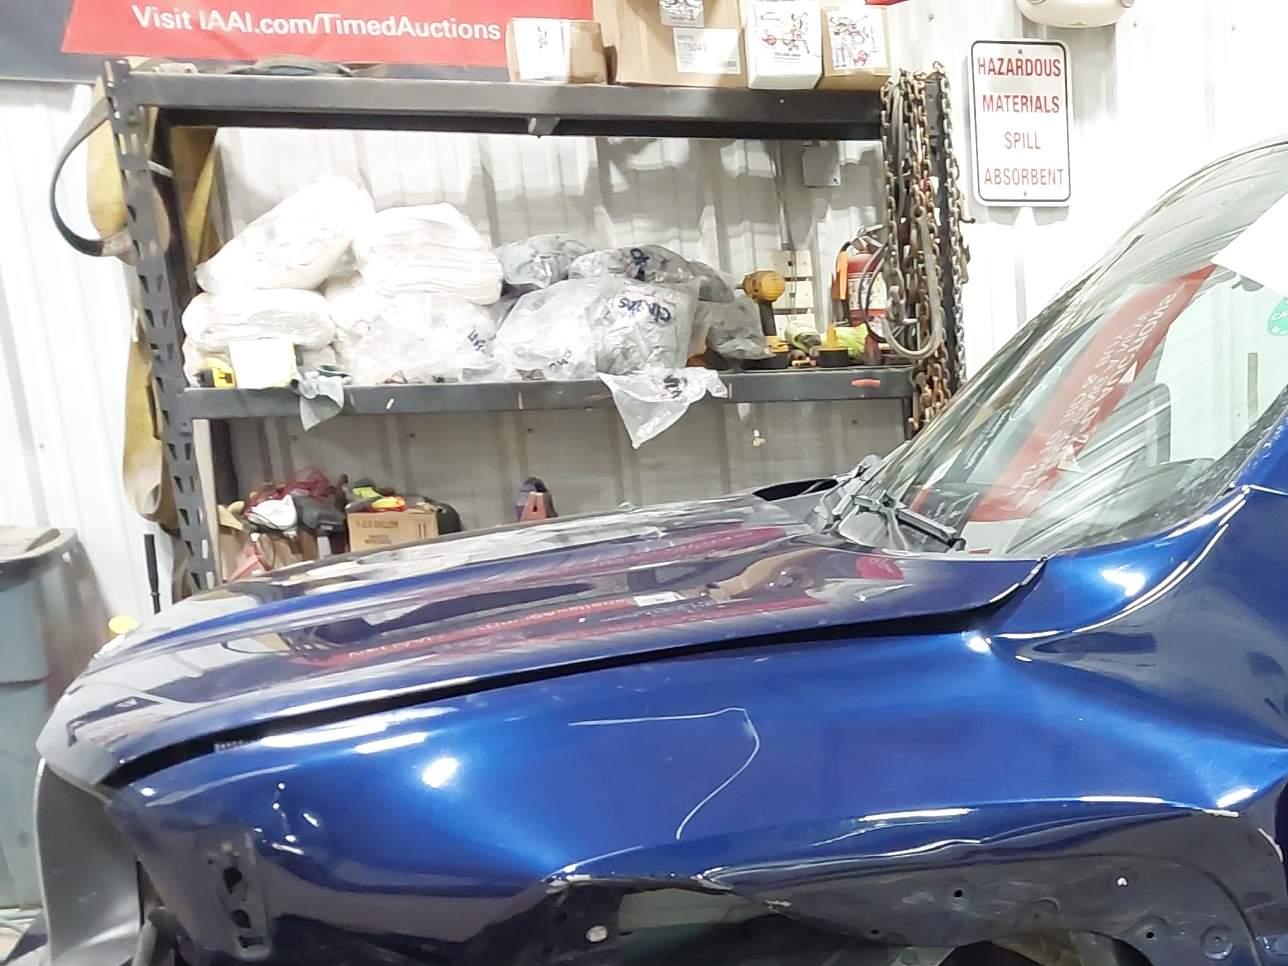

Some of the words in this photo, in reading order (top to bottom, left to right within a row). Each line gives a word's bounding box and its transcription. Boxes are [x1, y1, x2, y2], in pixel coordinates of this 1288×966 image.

[131, 4, 193, 30] Visit
[198, 9, 502, 40] IAAI.com/TimedAuctions
[977, 57, 1062, 77] HAZARDOUS
[982, 94, 1060, 114] MATERIALS
[1004, 131, 1041, 150] SPILL
[984, 168, 1064, 186] ABSORBENT
